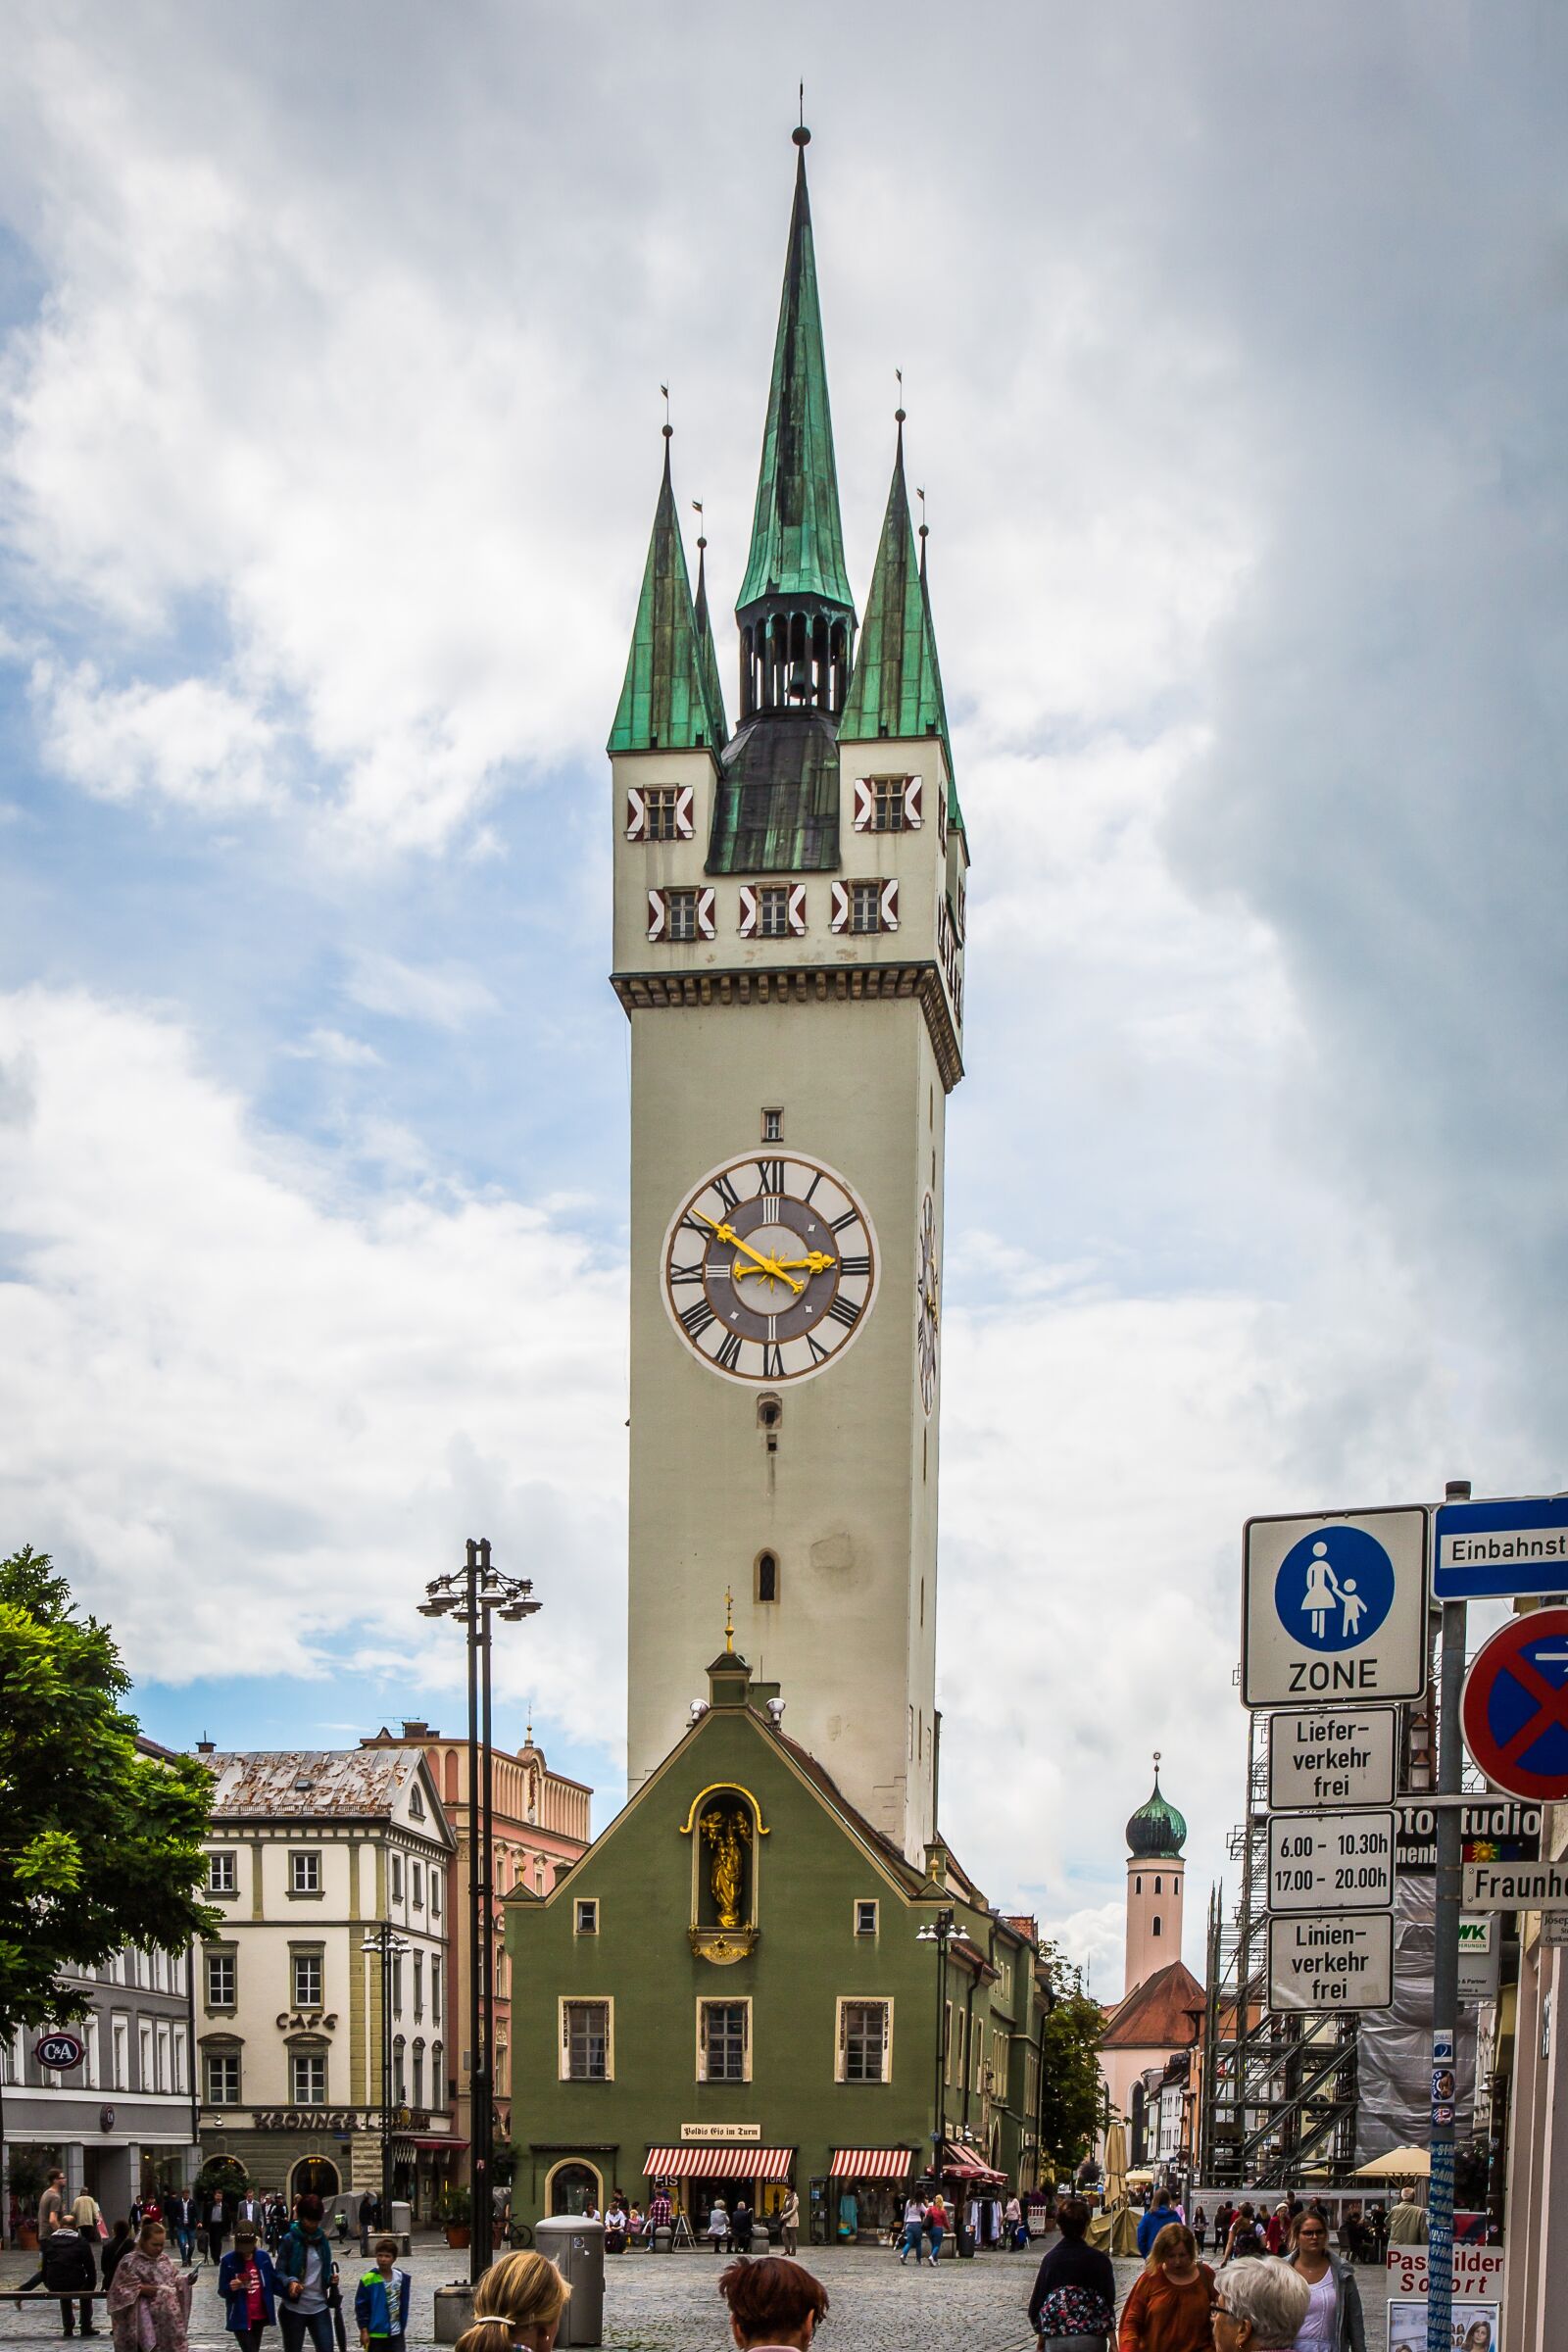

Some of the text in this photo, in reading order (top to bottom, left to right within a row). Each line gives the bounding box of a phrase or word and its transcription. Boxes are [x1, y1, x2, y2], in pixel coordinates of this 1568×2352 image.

[1288, 1658, 1378, 1692] ZONE
[1297, 1720, 1370, 1742] Liefer-
[1293, 1748, 1372, 1771] verkehr
[1313, 1775, 1349, 1797] frei
[1280, 1836, 1313, 1858] 6.00
[1338, 1833, 1388, 1855] 10.30h
[1275, 1870, 1313, 1891] 17.00
[1335, 1867, 1387, 1889] 20.00h
[1296, 1925, 1367, 1946] Linien-
[1291, 1951, 1369, 1974] verkehr
[1312, 1979, 1348, 2000] frei
[44, 2043, 73, 2060] C&A
[684, 2128, 708, 2136] Poldis
[710, 2127, 723, 2135] Eis
[1400, 2274, 1488, 2294] Soort
